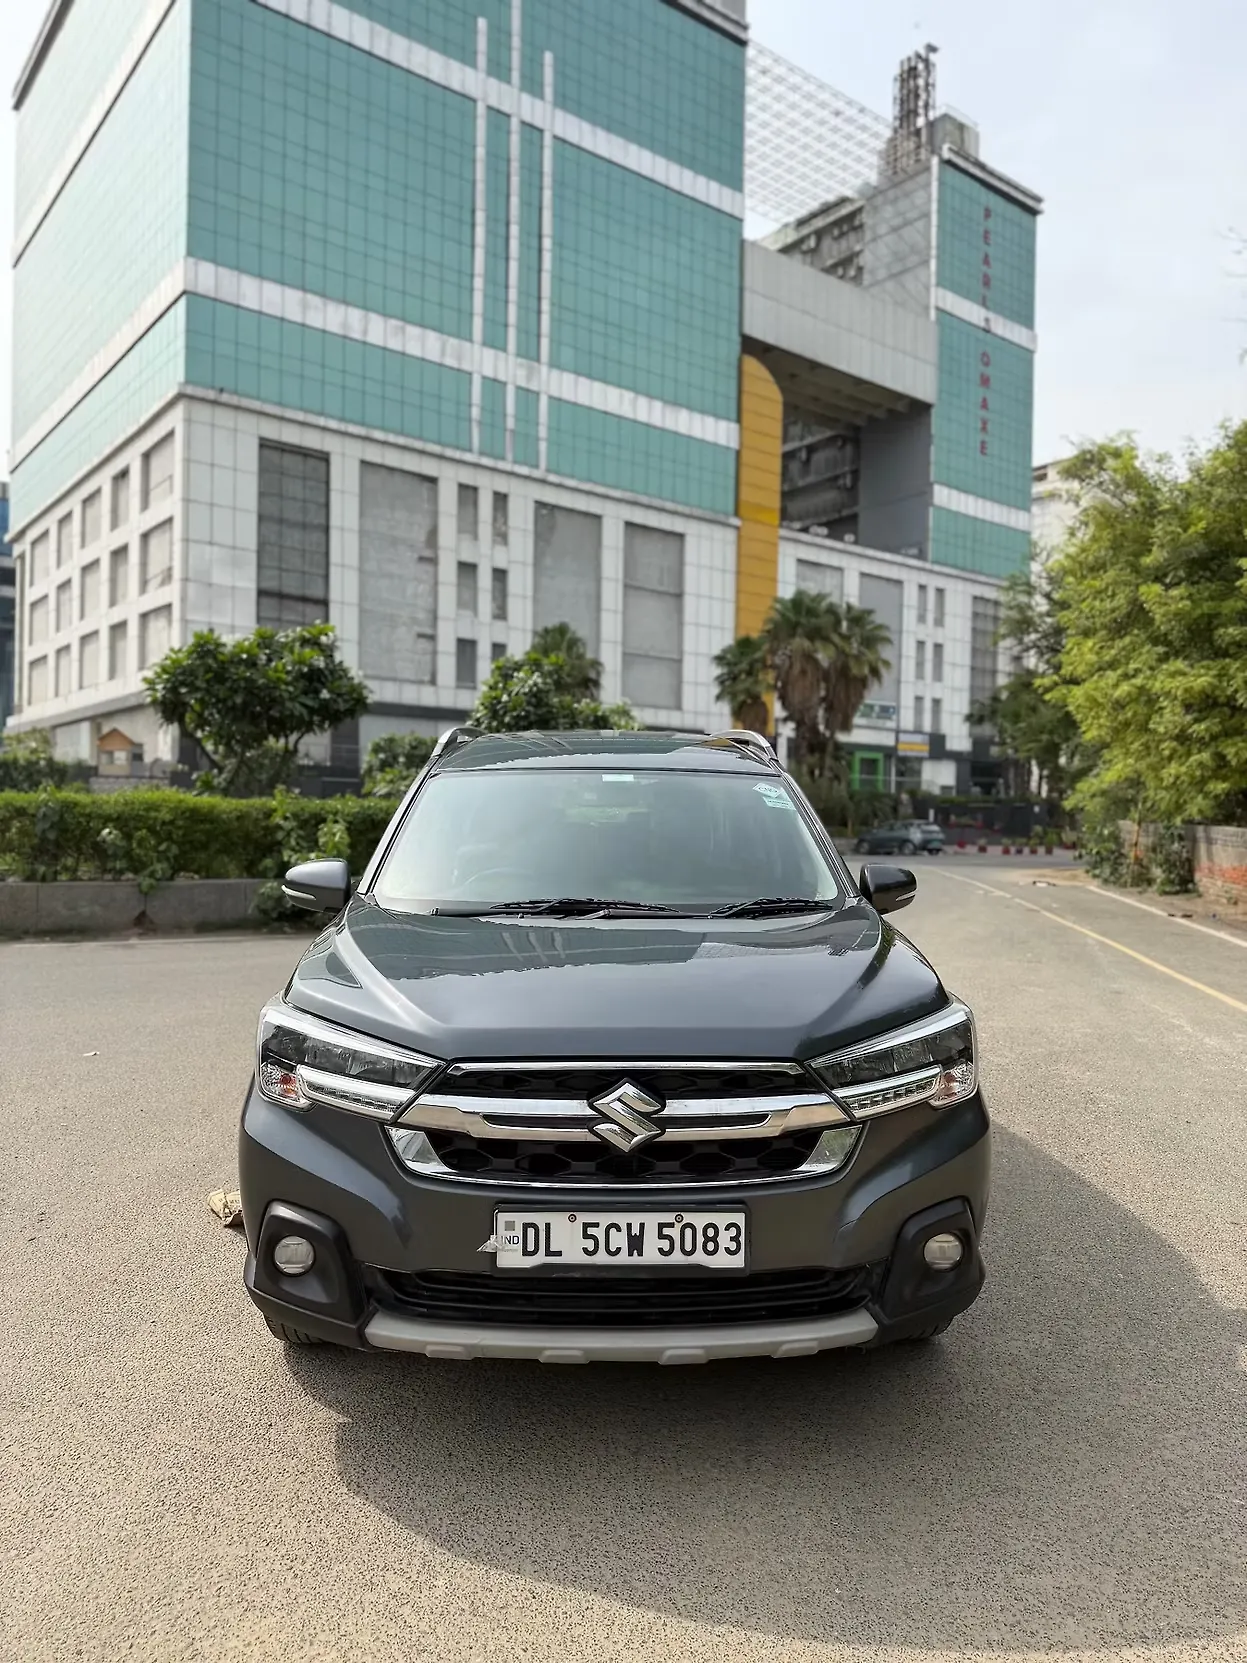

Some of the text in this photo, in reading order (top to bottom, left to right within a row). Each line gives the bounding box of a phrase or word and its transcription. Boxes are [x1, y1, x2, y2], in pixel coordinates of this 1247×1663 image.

[979, 350, 991, 457] OMAXE
[501, 1235, 520, 1245] IND
[521, 1222, 742, 1257] DL 5CW 5083
